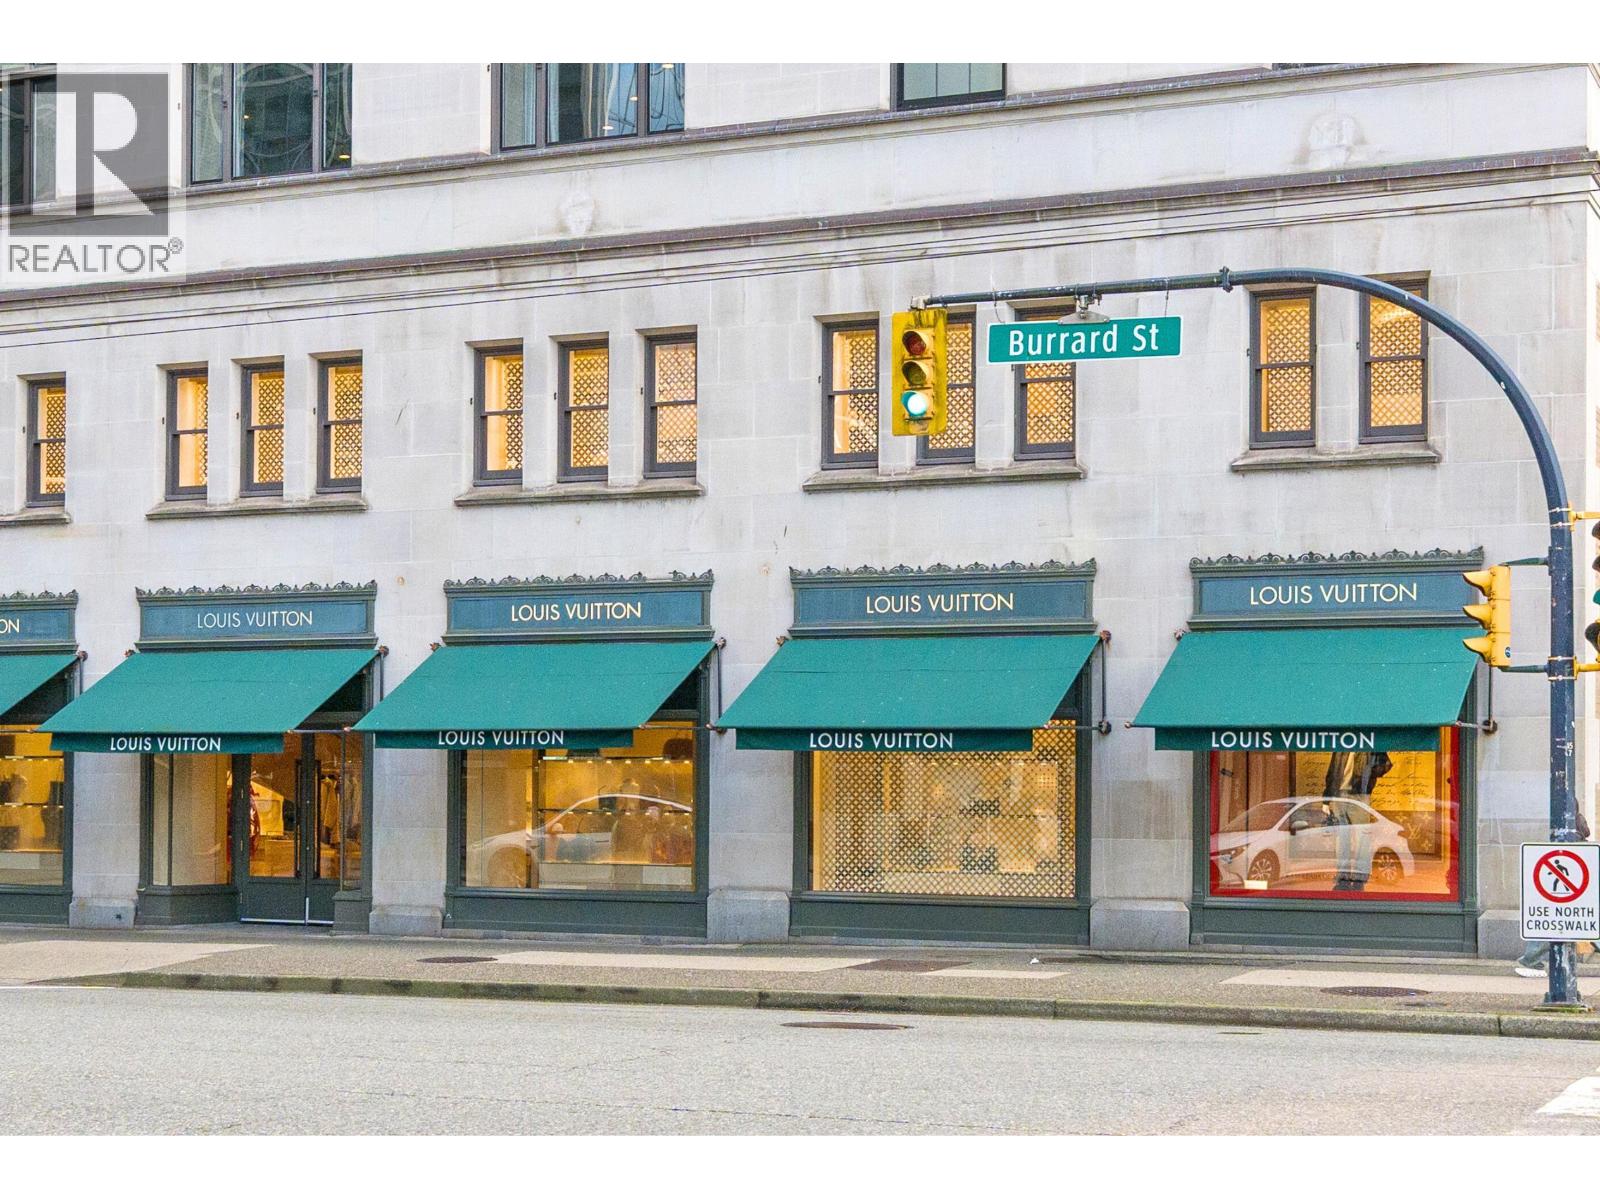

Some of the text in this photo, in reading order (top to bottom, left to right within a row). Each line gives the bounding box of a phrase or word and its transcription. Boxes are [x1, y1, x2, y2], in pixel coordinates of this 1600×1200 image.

[1009, 323, 1159, 356] Burrard St
[1250, 582, 1417, 605] LOUIS VUITTON
[511, 601, 642, 622] LOUIS VUITTON
[865, 592, 1014, 614] LOUIS VUITTON
[196, 610, 313, 629] LOUIS VUITTON
[110, 737, 221, 752] LOUIS VUITTON
[438, 730, 564, 746] LOUIS VUITTON
[809, 732, 953, 749] LOUIS VUITTON
[1211, 731, 1375, 749] LOUIS VUITTON
[1528, 906, 1595, 918] USE NORTH
[1526, 919, 1597, 931] CROSSWALK
